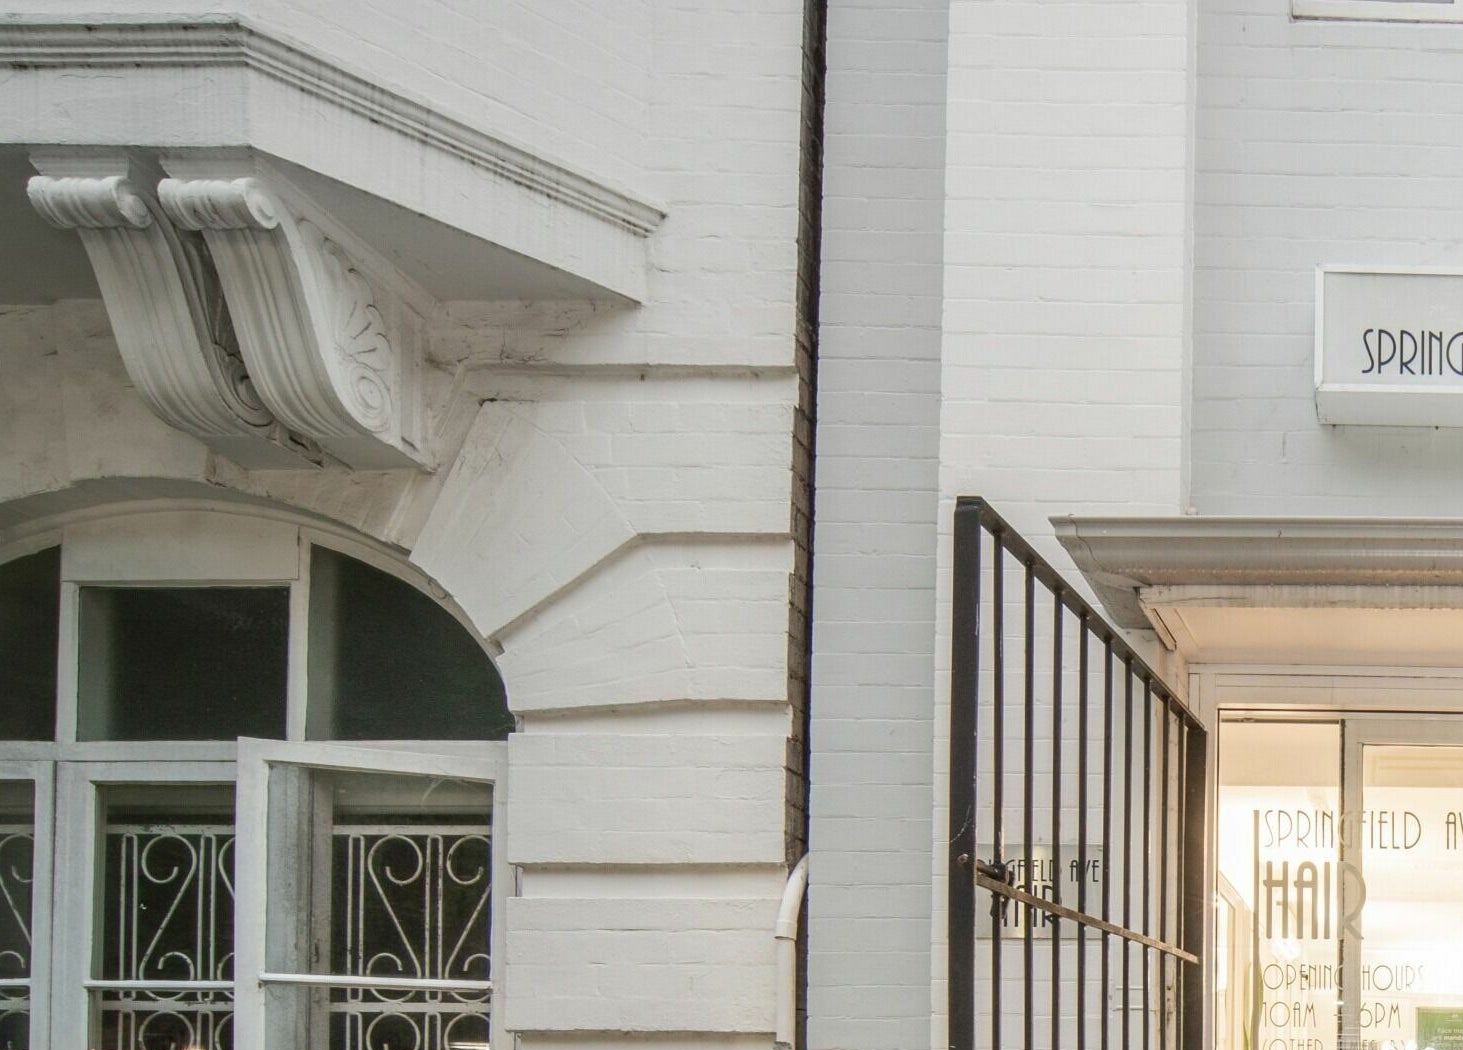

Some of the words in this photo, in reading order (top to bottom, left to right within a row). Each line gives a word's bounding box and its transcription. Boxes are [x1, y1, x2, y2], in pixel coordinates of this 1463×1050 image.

[1264, 809, 1422, 850] SPRINGFIELD
[1263, 860, 1367, 940] HAIR
[1362, 964, 1425, 991] HOURS
[1263, 1001, 1317, 1029] 10AM
[1360, 1001, 1402, 1029] 6PM
